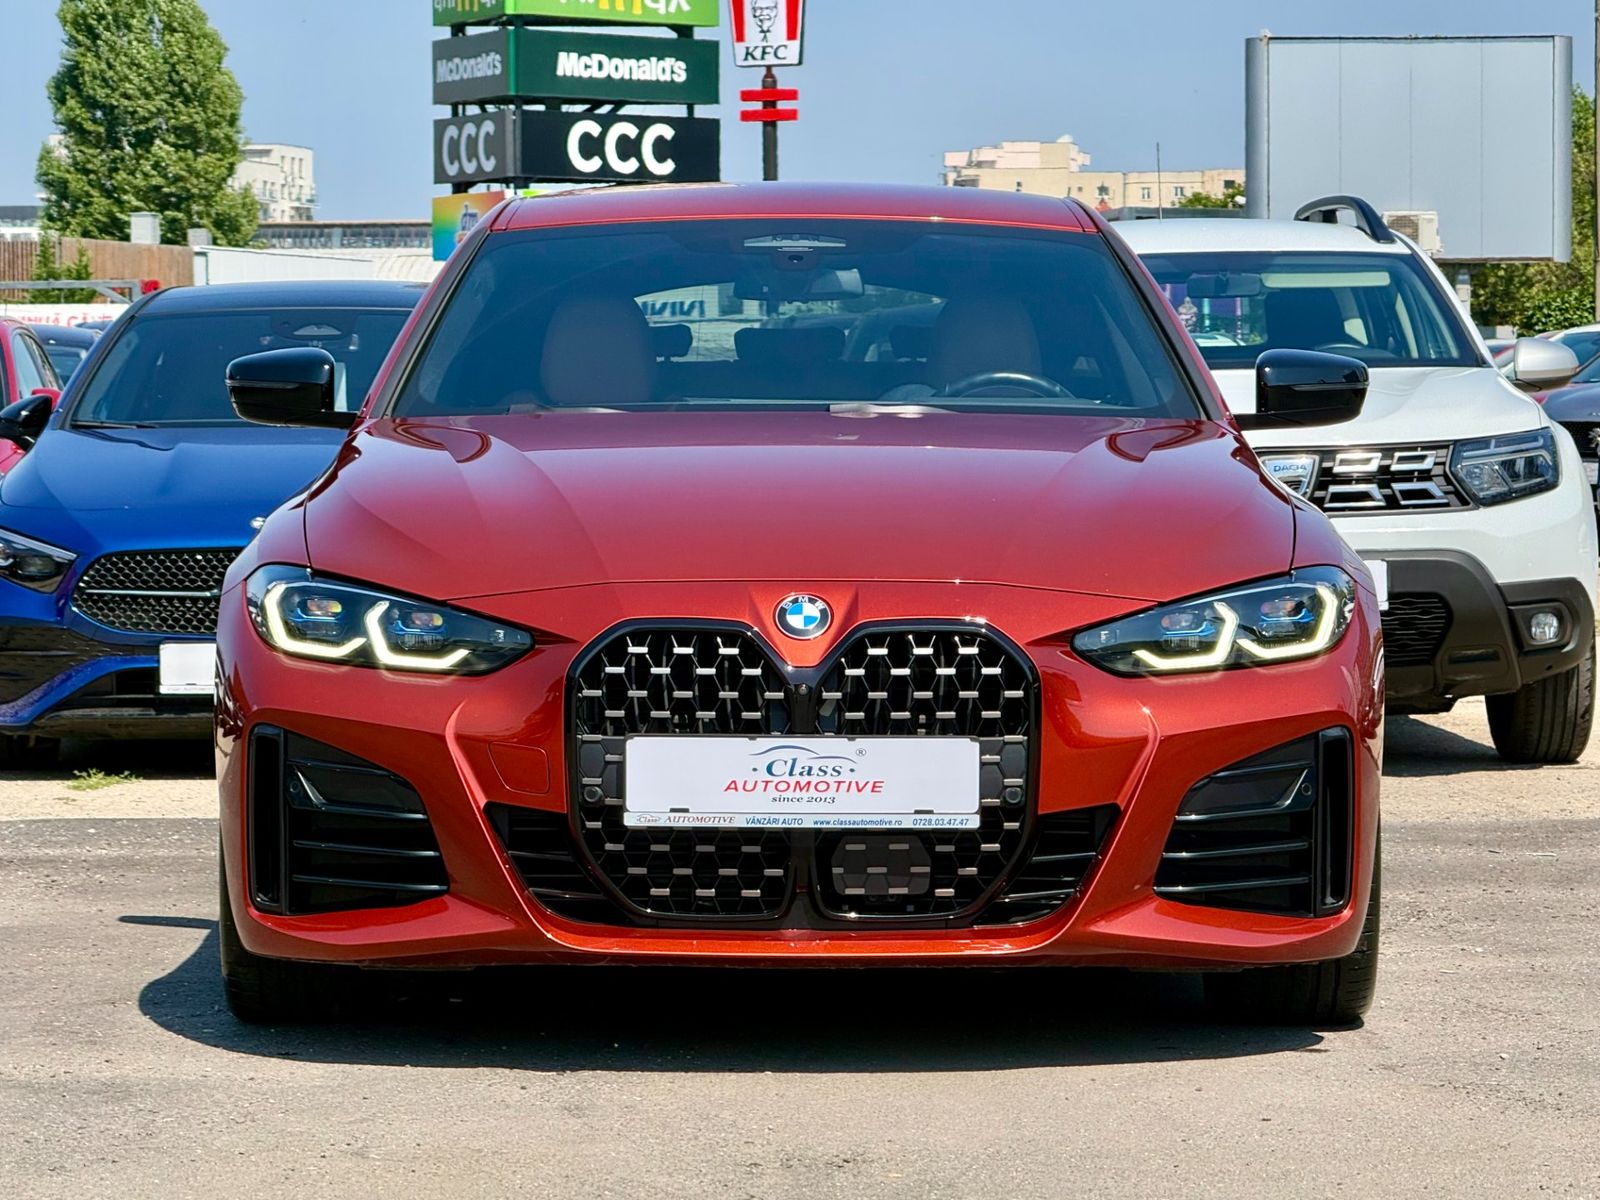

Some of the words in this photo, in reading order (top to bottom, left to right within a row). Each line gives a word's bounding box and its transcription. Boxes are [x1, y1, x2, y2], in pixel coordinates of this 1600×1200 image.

[743, 44, 788, 61] KFC
[436, 52, 502, 83] McDonald's
[556, 52, 687, 82] McDonald's
[441, 120, 497, 177] CCC
[566, 119, 676, 176] CCC
[1273, 464, 1307, 472] DACIA
[782, 596, 826, 610] BMW
[765, 758, 843, 777] Class
[724, 780, 885, 793] AUTOMOTIVE
[771, 794, 803, 803] since
[806, 795, 836, 805] 2013
[664, 815, 735, 825] AUTOMOTIVE
[781, 817, 804, 826] AUTO
[813, 817, 903, 827] www.classautomotive.ro
[912, 817, 969, 827] 0728.03.47.47
